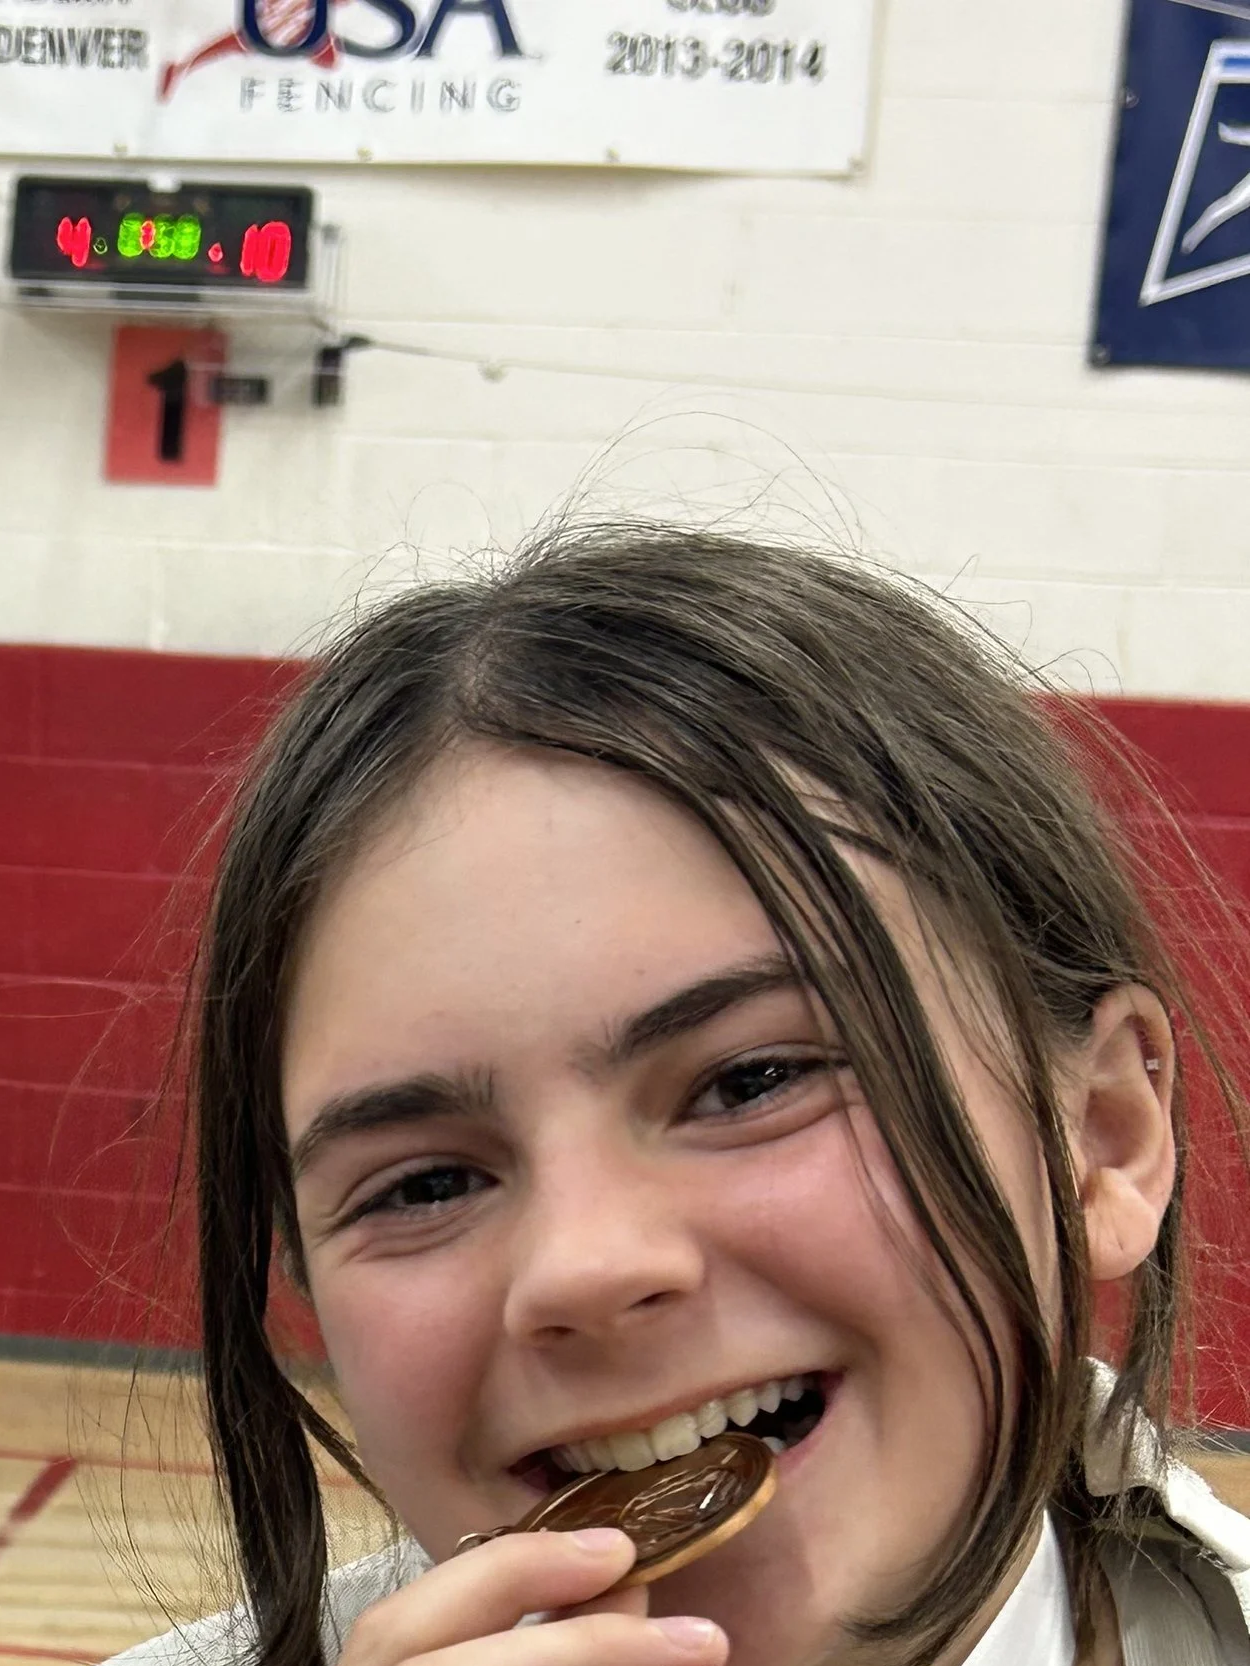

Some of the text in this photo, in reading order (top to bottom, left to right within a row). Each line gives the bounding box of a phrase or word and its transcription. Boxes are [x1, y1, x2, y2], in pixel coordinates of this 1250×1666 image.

[606, 31, 827, 83] 2013-2014
[240, 76, 522, 112] FENCING
[240, 221, 291, 282] 10
[146, 358, 188, 463] 1
